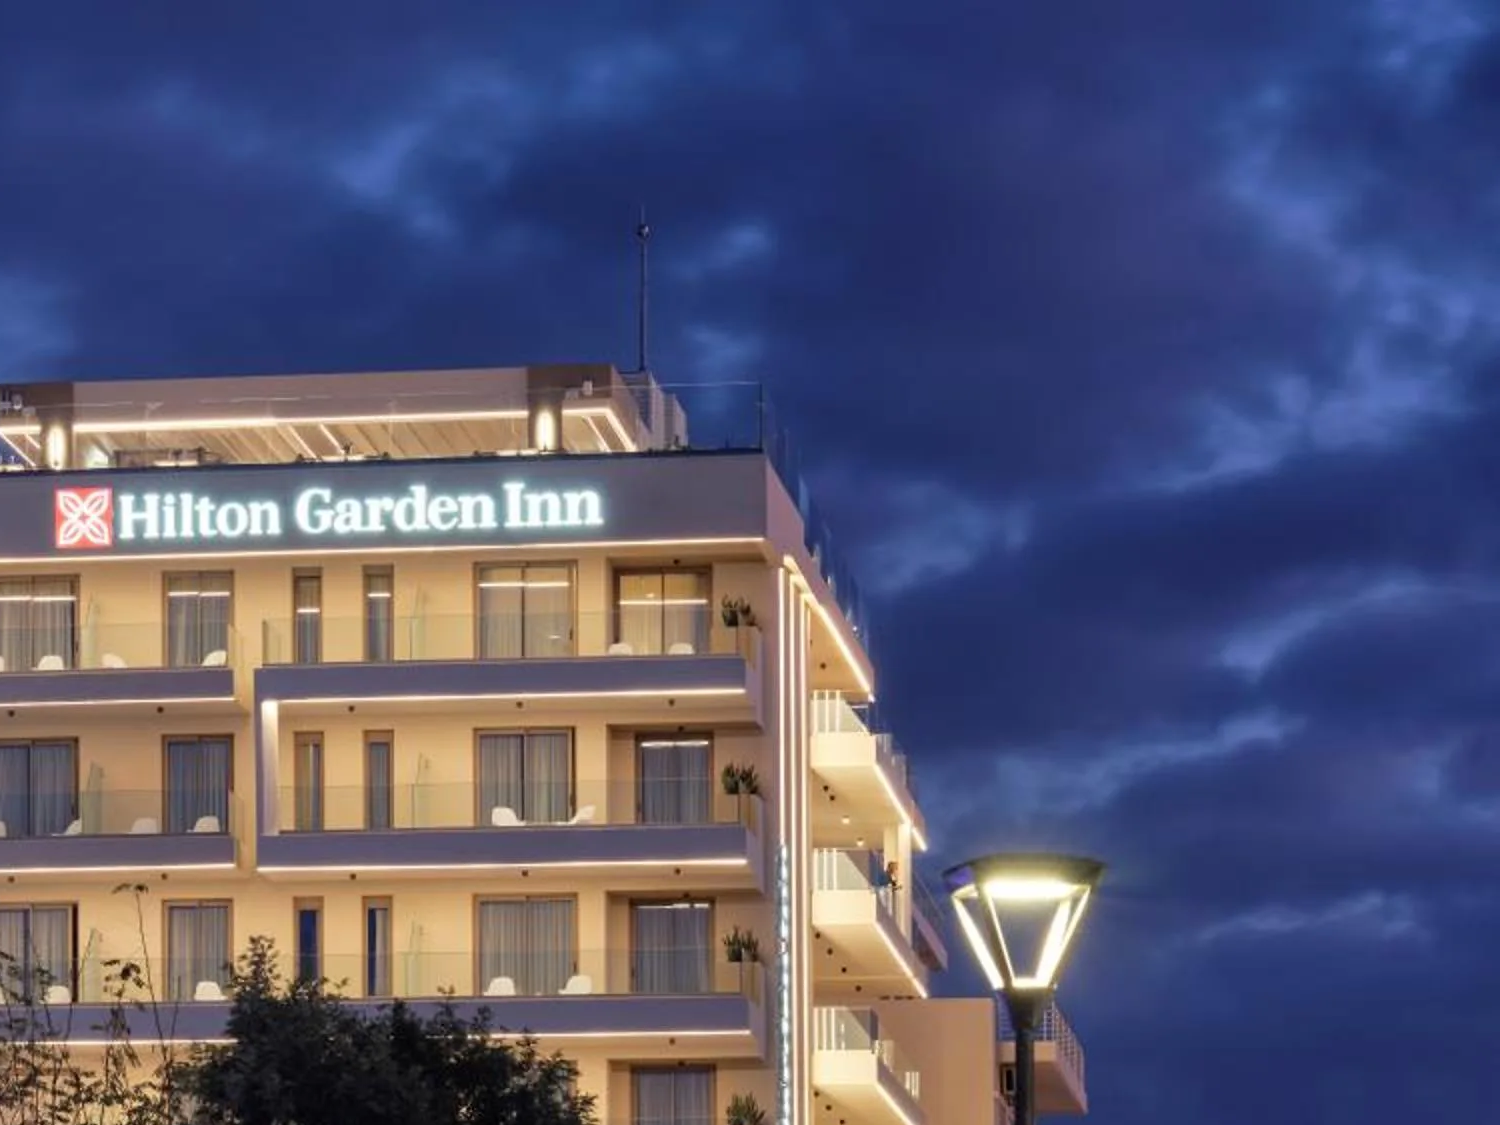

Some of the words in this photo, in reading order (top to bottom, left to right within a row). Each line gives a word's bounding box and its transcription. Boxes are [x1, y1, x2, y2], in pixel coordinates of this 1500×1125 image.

[118, 492, 282, 539] Hilton
[295, 485, 498, 534] Garden
[503, 482, 604, 528] Inn
